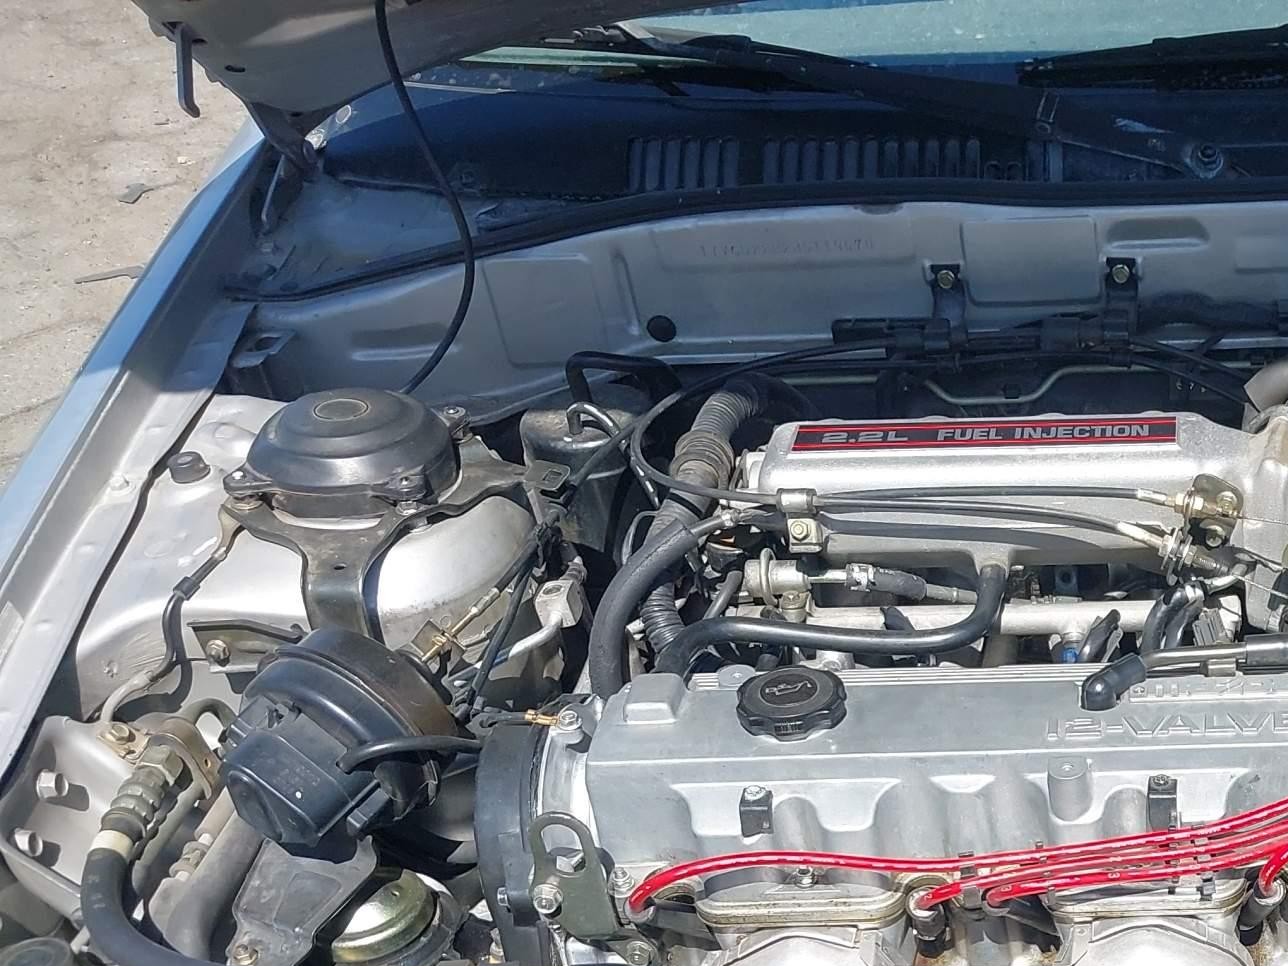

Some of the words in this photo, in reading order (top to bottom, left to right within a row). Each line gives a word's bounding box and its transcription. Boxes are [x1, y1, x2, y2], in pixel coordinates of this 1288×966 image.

[821, 431, 908, 443] 2.2L
[937, 428, 1002, 441] FUEL
[1014, 424, 1149, 439] INJECTION
